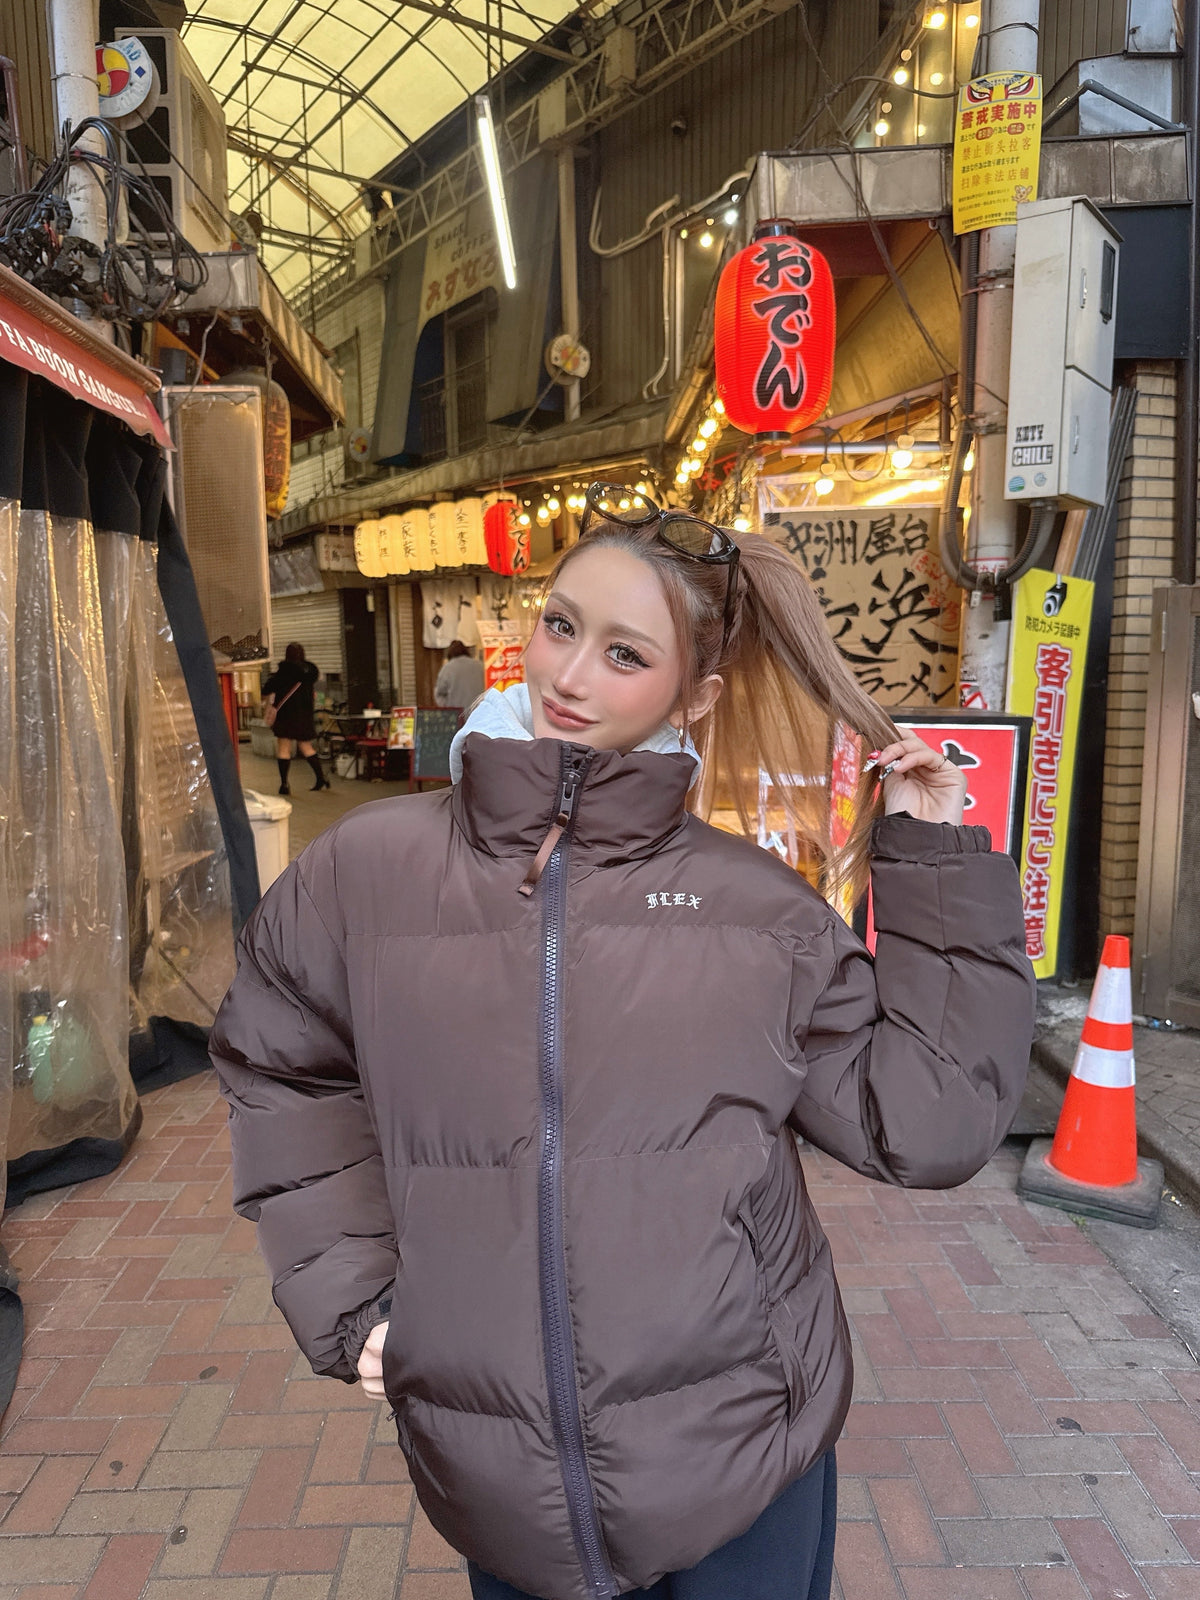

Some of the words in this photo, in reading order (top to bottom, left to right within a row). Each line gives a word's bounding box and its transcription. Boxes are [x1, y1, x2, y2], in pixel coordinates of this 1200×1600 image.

[961, 102, 1037, 130] 警戒実施中
[752, 242, 812, 409] おでん
[26, 336, 80, 387] BUON
[1013, 446, 1052, 466] CHILL
[781, 514, 930, 568] 中洲屋台
[1025, 615, 1081, 640] 防犯カメラ記録中
[853, 661, 956, 707] ラーメン
[1022, 643, 1072, 961] 客引きにご注意
